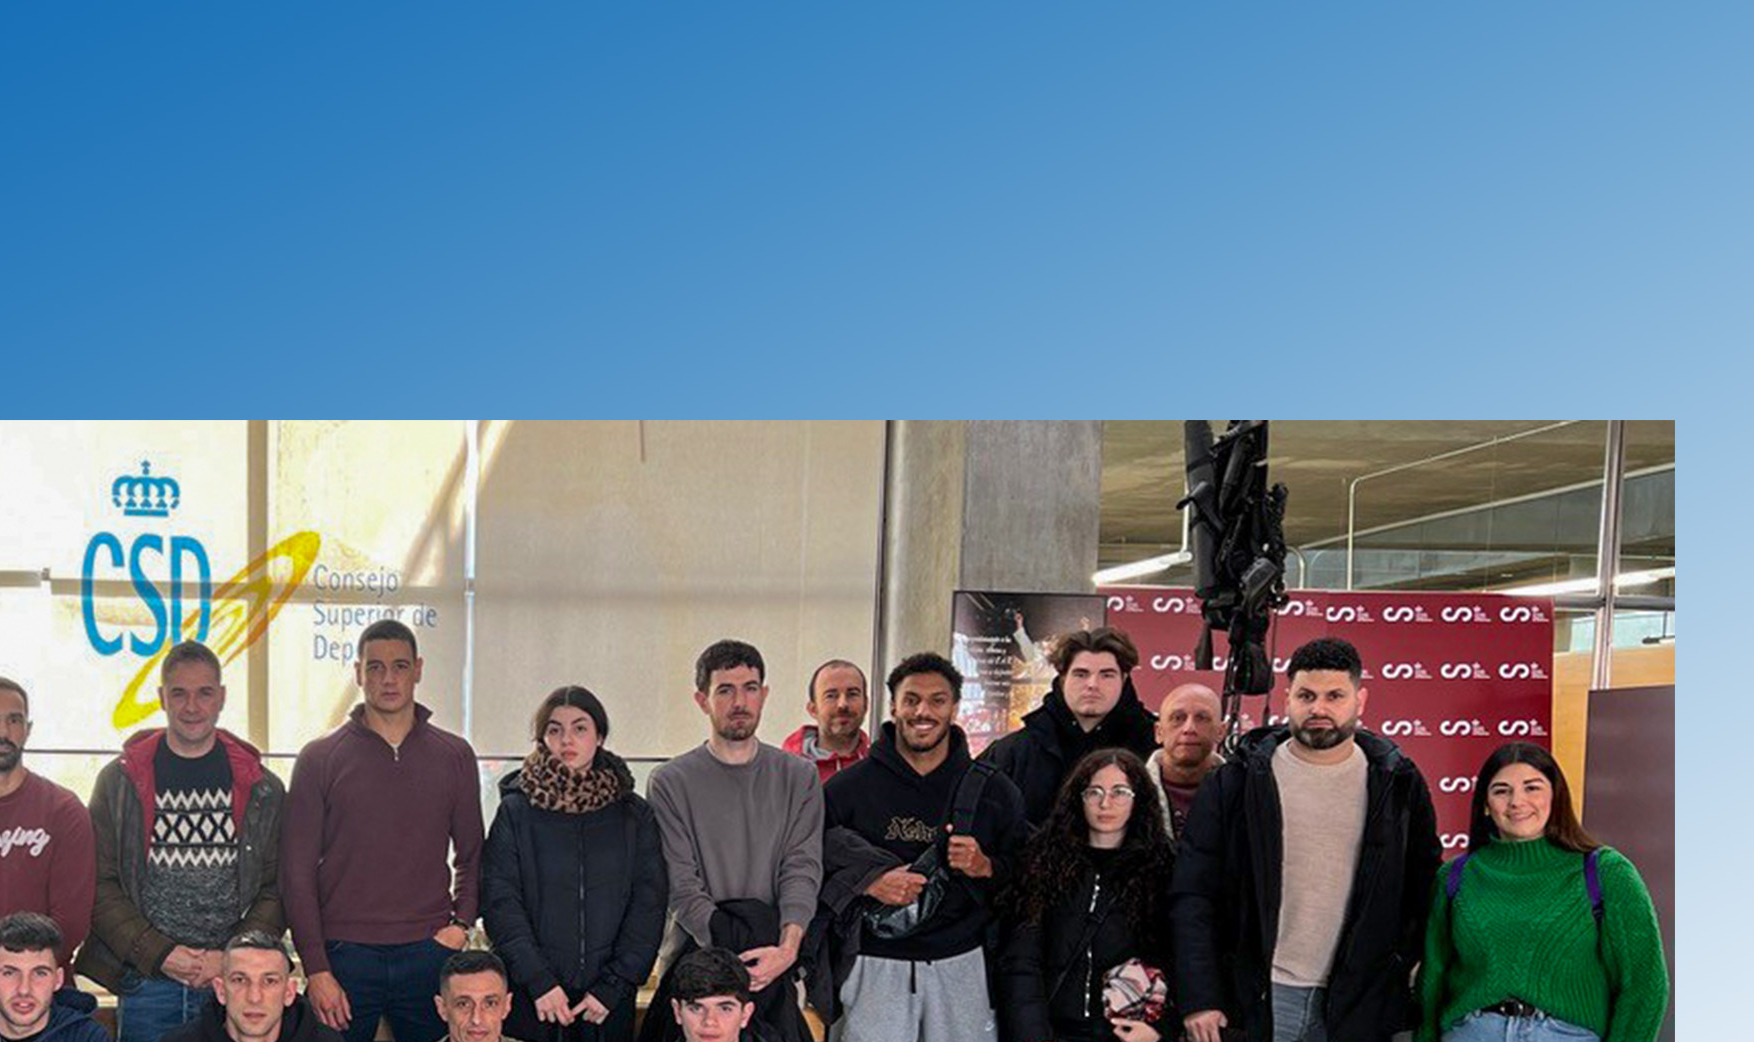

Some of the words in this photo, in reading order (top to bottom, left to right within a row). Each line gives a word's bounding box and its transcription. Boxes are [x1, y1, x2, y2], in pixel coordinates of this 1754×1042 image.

[81, 531, 212, 658] CSD
[313, 564, 399, 598] Consejo
[412, 602, 437, 628] de
